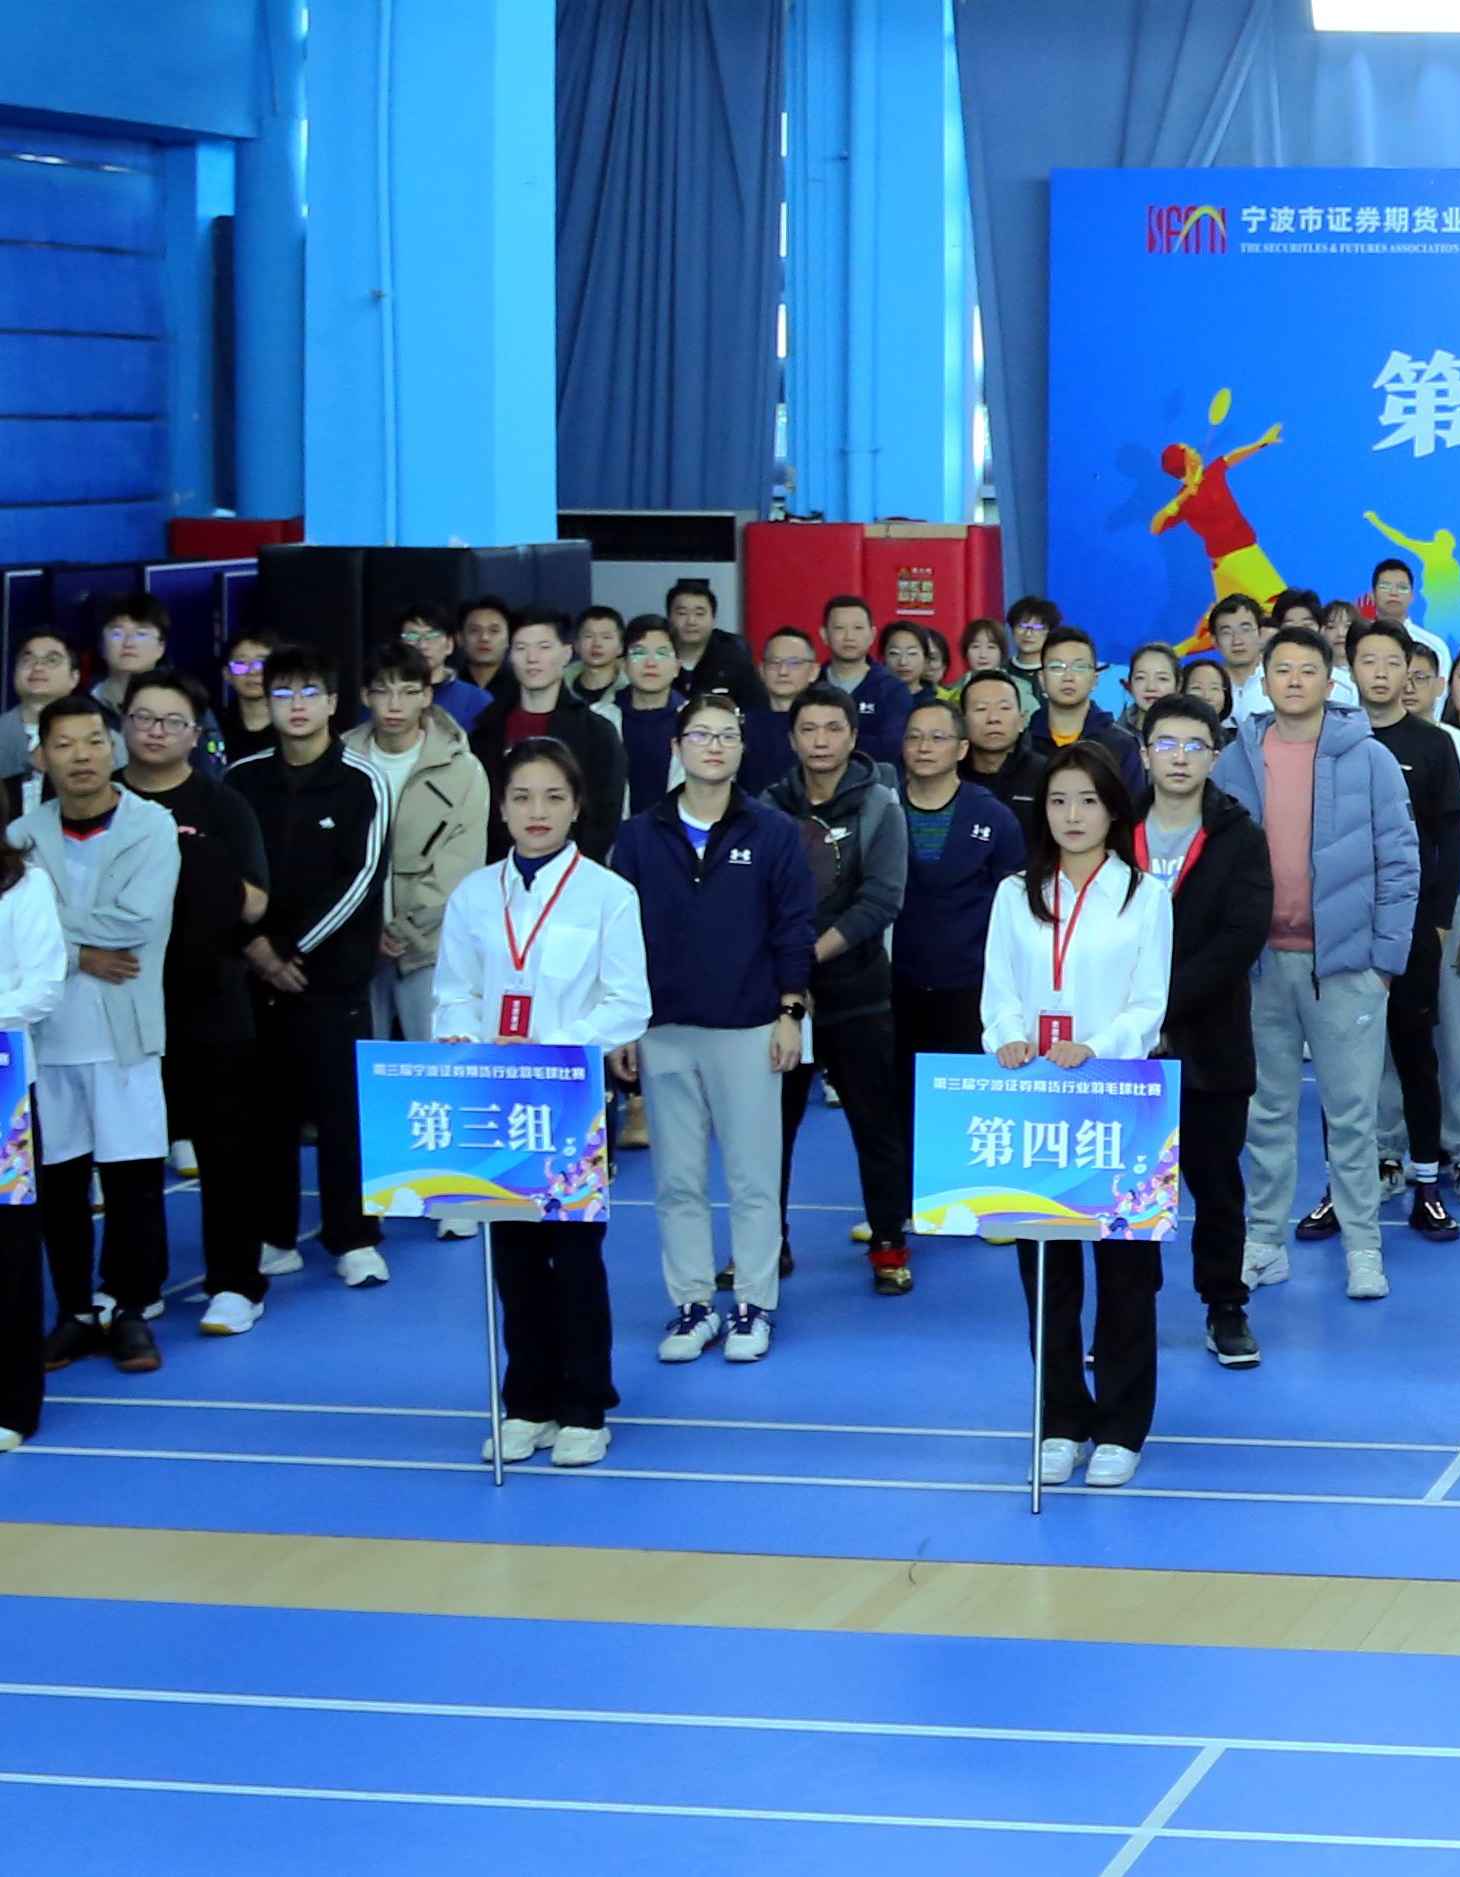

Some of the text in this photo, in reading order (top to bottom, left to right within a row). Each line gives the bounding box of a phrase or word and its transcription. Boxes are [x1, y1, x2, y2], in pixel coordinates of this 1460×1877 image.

[407, 1101, 557, 1152] 第三组
[966, 1115, 1126, 1170] 第四组
